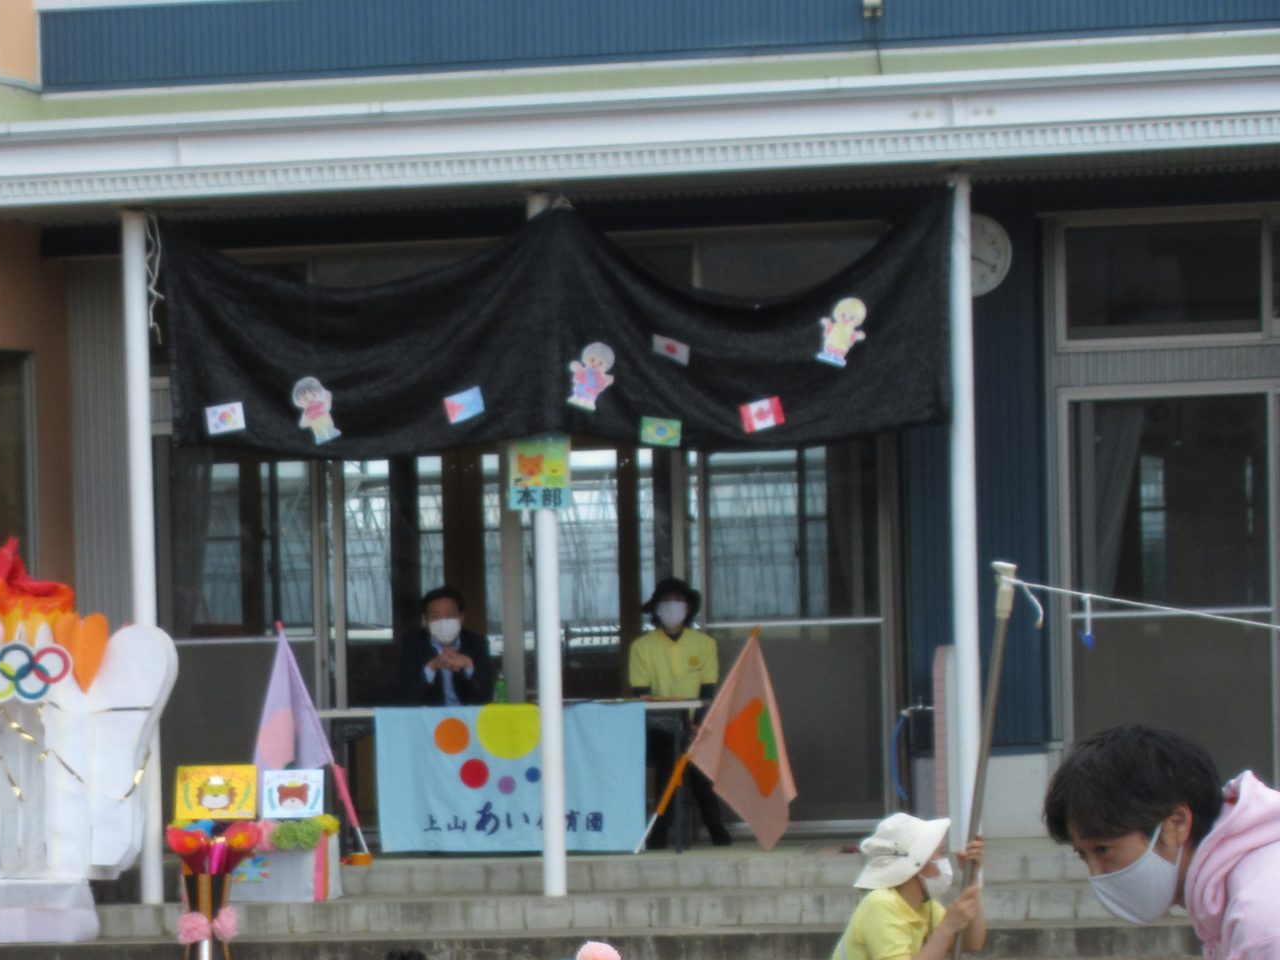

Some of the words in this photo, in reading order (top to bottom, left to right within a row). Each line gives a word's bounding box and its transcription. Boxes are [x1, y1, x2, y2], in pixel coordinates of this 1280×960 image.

[516, 487, 562, 507] 本部
[423, 801, 604, 835] 上山あい育園
